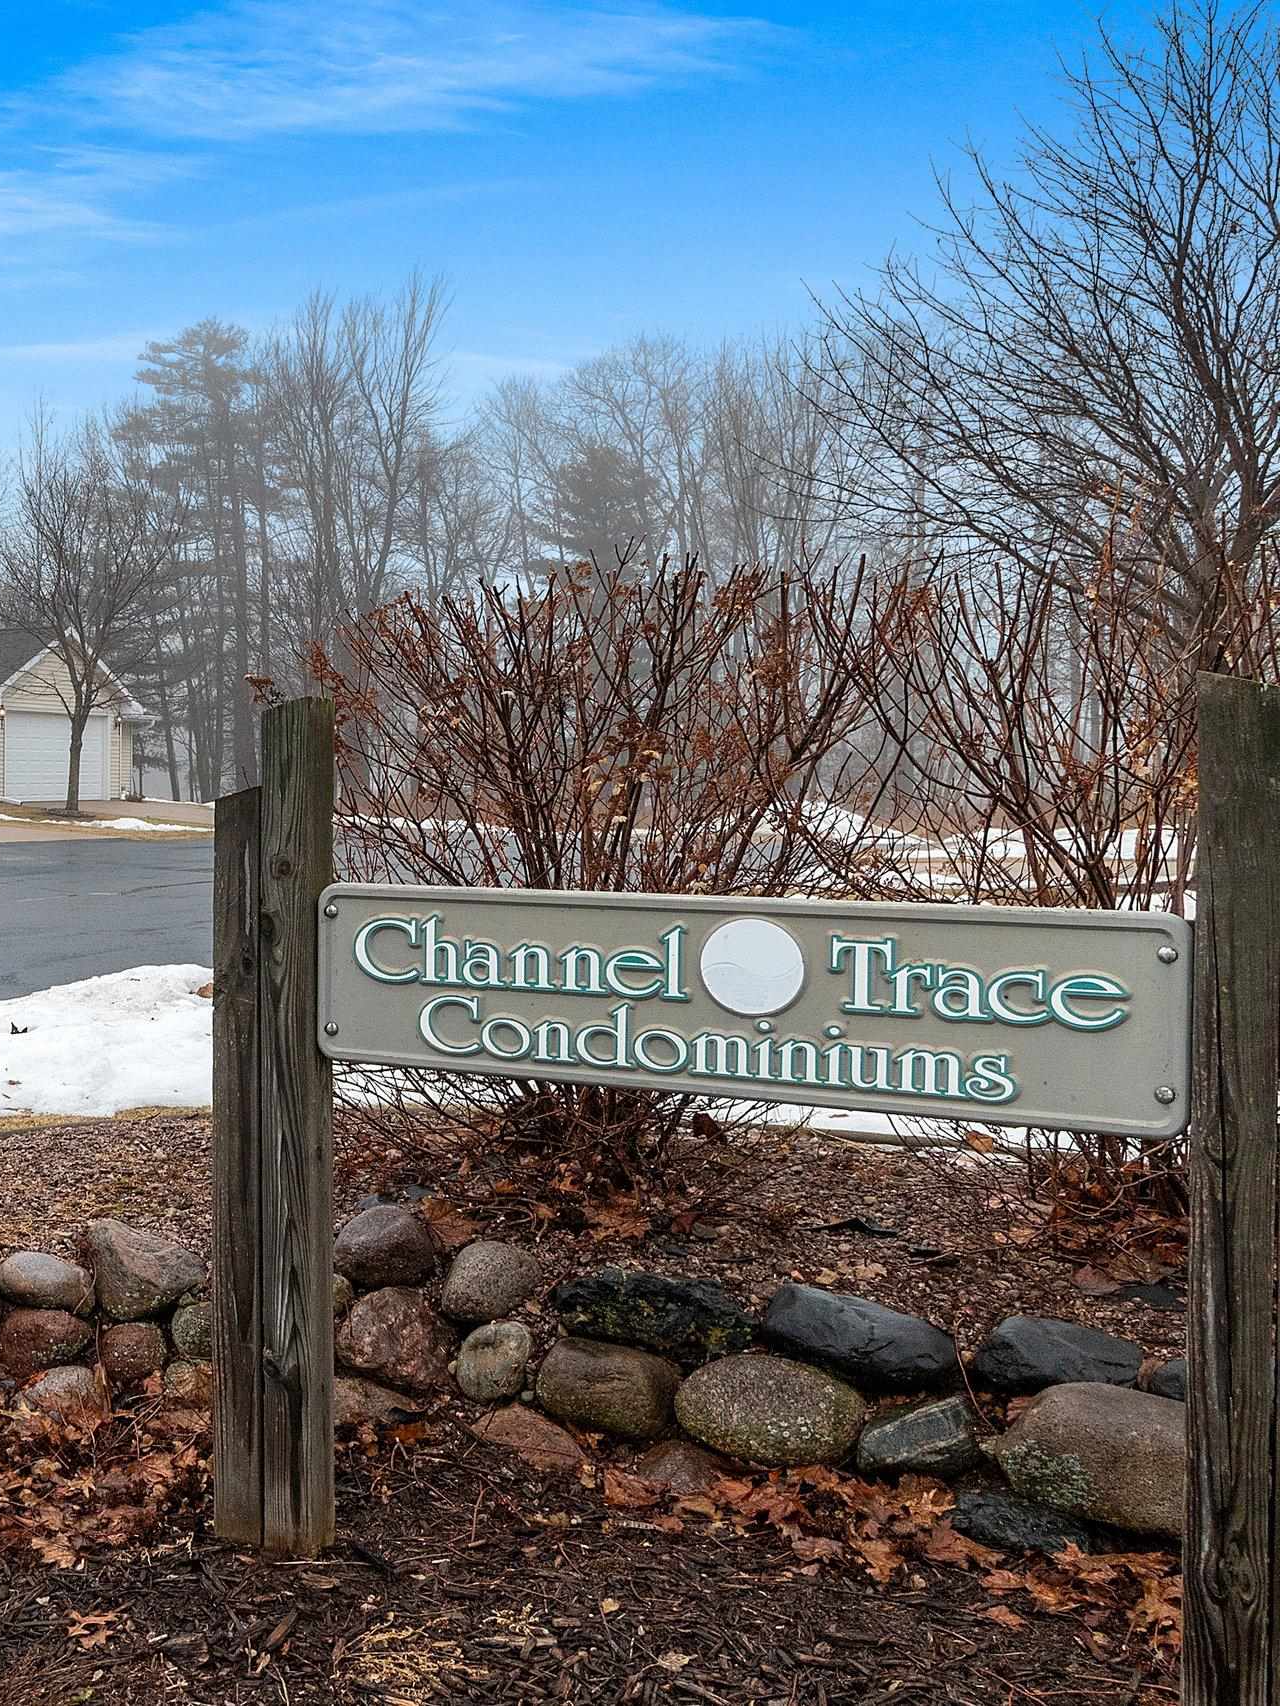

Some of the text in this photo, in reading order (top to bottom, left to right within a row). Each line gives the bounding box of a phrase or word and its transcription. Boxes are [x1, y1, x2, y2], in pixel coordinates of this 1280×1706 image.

[353, 913, 1130, 1032] Channel Trace
[418, 994, 1019, 1103] Condominiums
